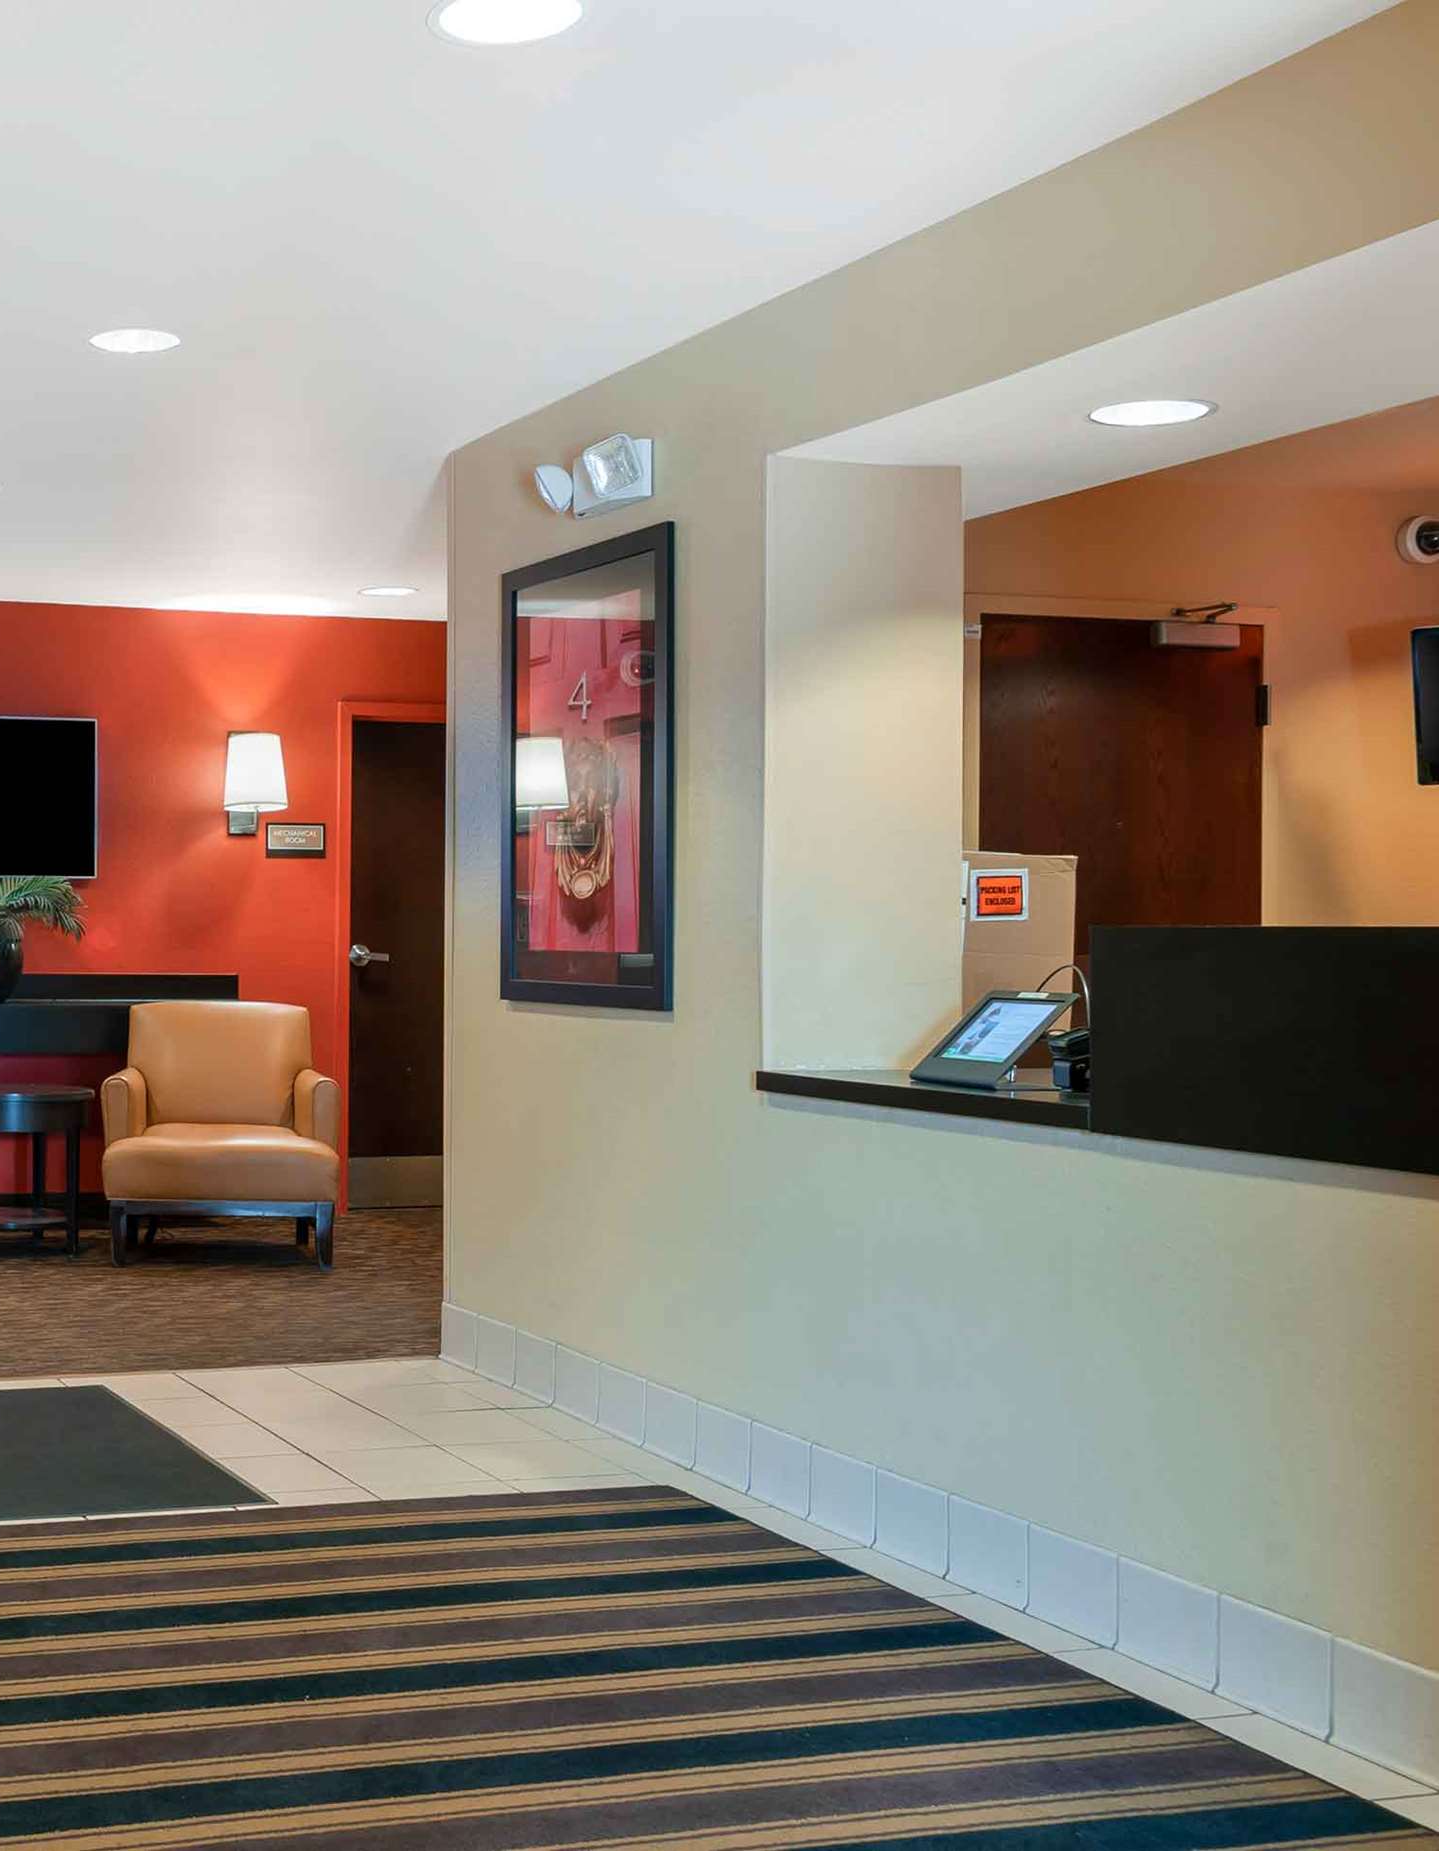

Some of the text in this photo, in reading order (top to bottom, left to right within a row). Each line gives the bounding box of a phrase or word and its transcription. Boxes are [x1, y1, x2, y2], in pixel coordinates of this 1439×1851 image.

[567, 671, 593, 720] 4
[980, 885, 1021, 895] PACKING LIST
[985, 897, 1016, 906] ENCLOSED
